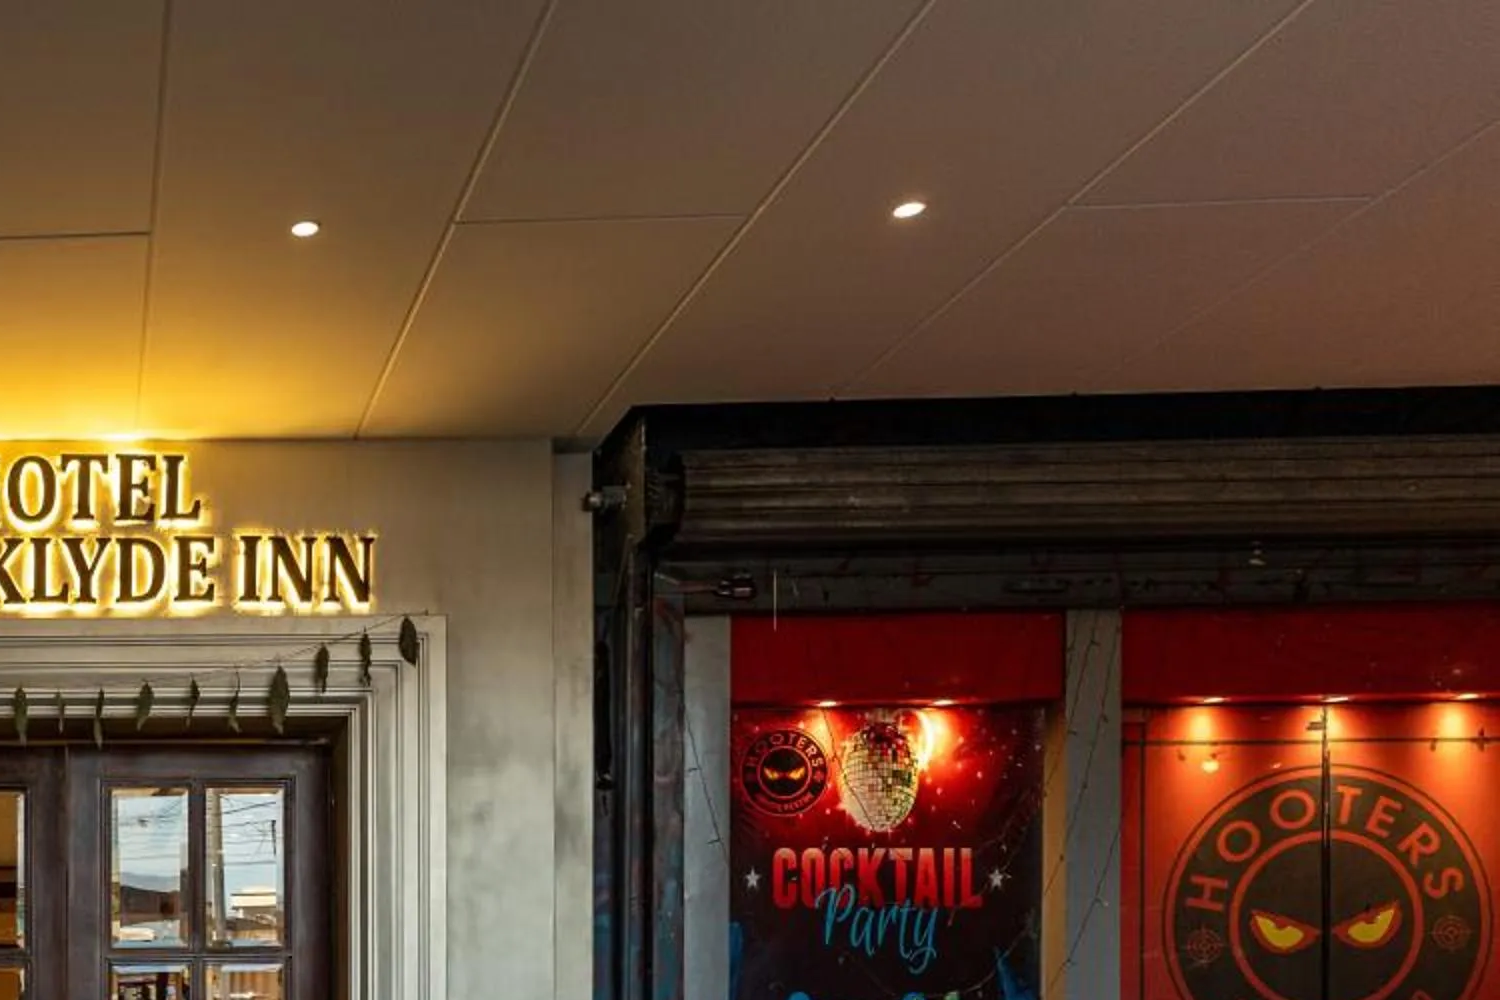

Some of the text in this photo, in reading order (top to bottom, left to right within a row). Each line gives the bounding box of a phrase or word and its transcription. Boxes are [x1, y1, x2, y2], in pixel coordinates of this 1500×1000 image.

[238, 535, 376, 604] INN
[745, 733, 824, 768] HOOTERS
[772, 847, 984, 909] COCKTAIL
[1186, 784, 1465, 912] HOOTERS
[814, 883, 938, 975] Party
